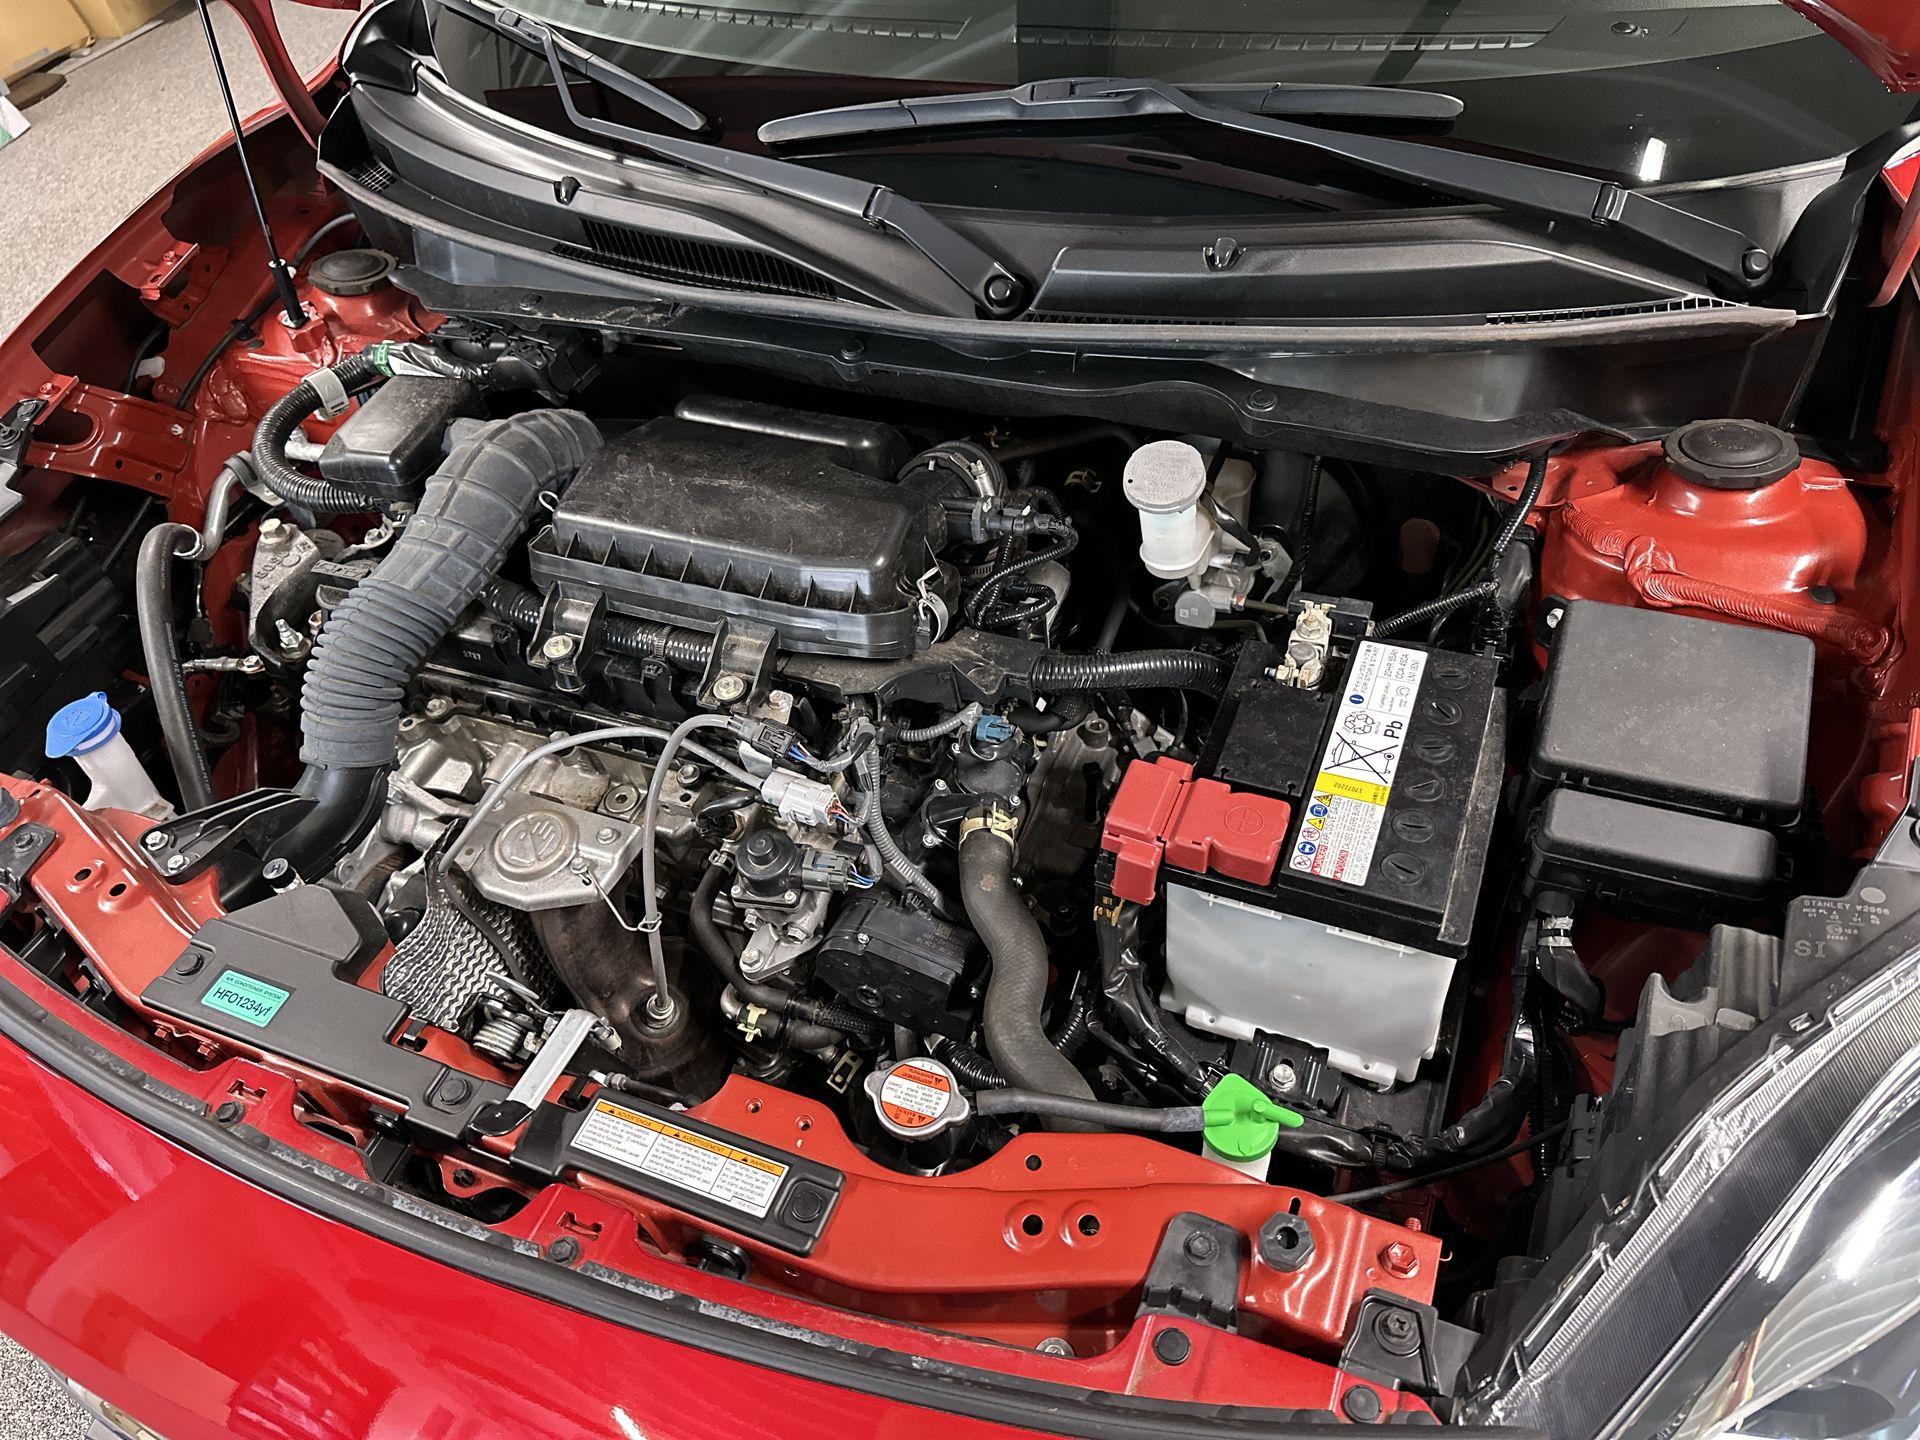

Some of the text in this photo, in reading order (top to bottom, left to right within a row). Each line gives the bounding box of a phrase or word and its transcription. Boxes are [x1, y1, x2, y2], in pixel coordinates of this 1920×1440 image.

[1369, 646, 1380, 662] START
[1364, 667, 1373, 681] STOP
[1394, 667, 1406, 679] CCA
[1360, 682, 1369, 693] FOR
[1384, 720, 1403, 739] Pb
[1351, 801, 1362, 816] BURNS
[1313, 844, 1327, 866] DANGER
[1320, 815, 1336, 844] EXPLOSIVE
[1330, 796, 1342, 814] GASES
[1346, 816, 1358, 832] SEVERE
[1341, 831, 1353, 849] CAUSES
[1334, 849, 1348, 872] POISON
[1804, 899, 1850, 910] STANLEY
[234, 979, 264, 993] CONDITIONER
[263, 990, 282, 1000] SYSTEM
[212, 986, 273, 1017] HFO1234yf
[616, 1110, 652, 1127] ADVERTENCIA
[681, 1134, 724, 1153] AVERTISSEMENT
[749, 1158, 775, 1171] WARNING
